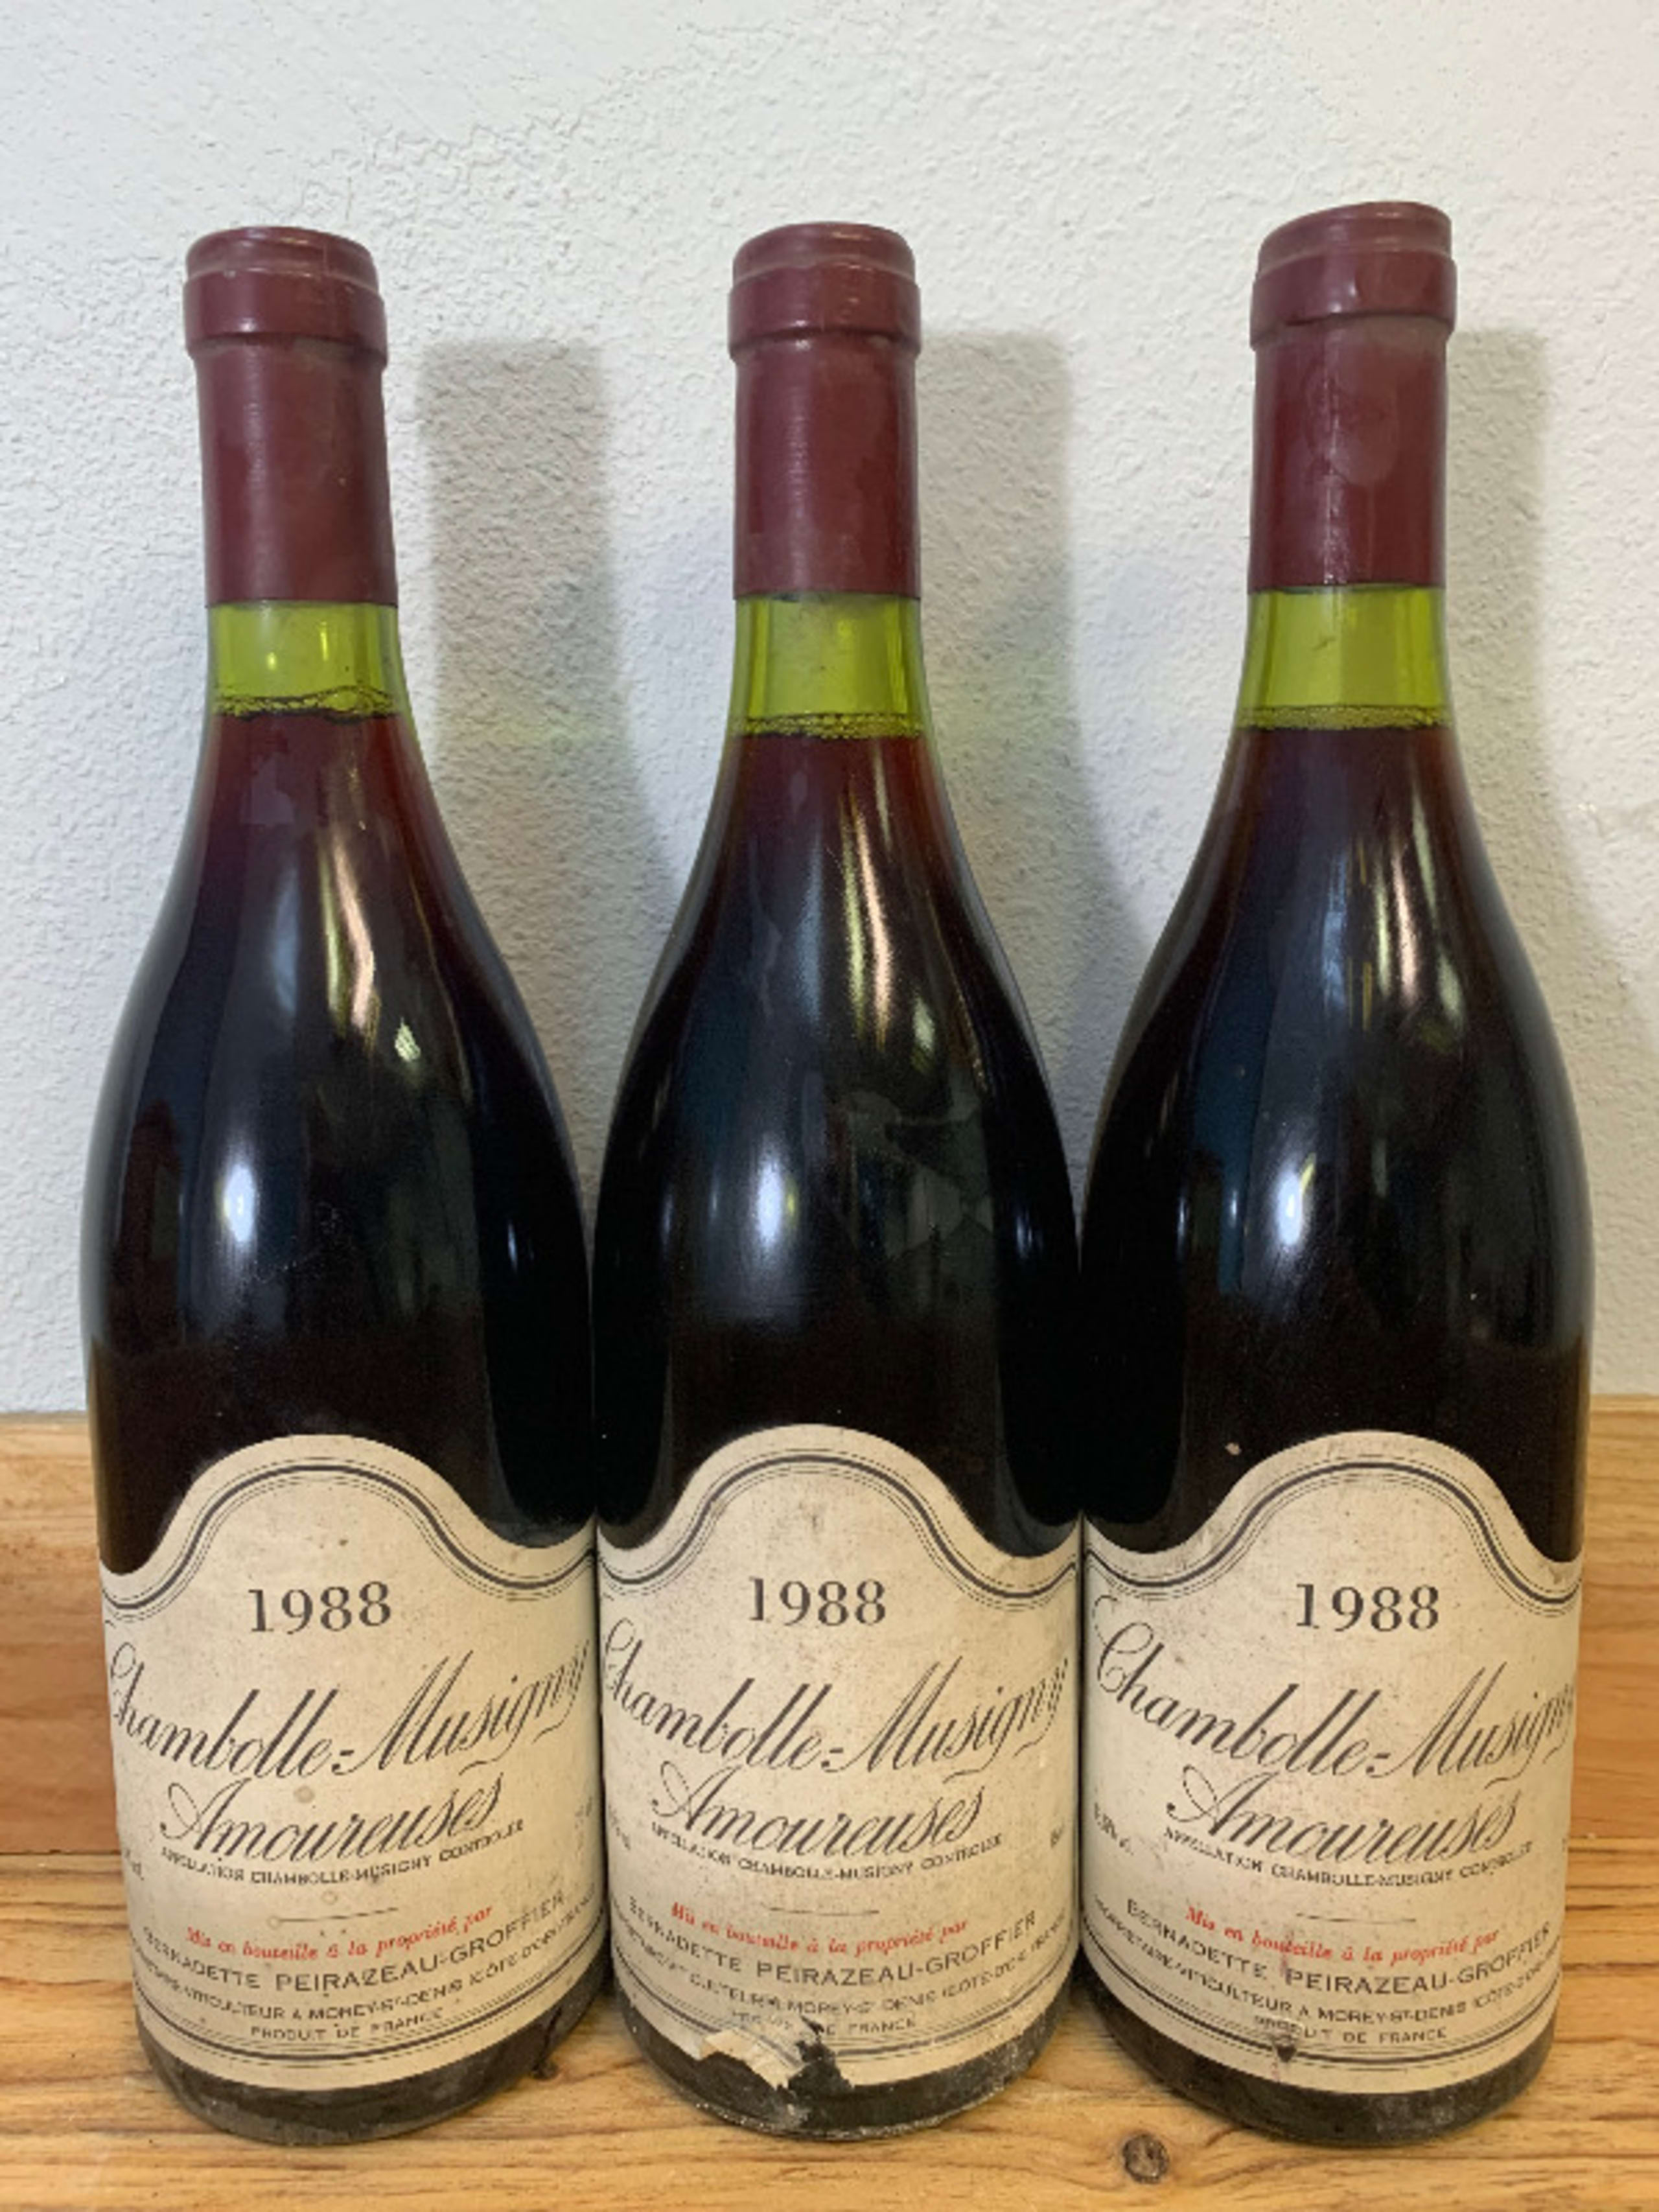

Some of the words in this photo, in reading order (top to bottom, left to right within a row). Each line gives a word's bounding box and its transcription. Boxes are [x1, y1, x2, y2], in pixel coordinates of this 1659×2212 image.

[248, 1581, 392, 1635] 1988
[748, 1576, 887, 1627] 1988
[1295, 1583, 1439, 1633] 1988
[159, 1771, 504, 1862] Amoureuses
[651, 1760, 985, 1858] Amoureuses
[1166, 1765, 1522, 1863] Amoureuses
[187, 1925, 211, 1948] Mis
[218, 1941, 236, 1953] en
[242, 1940, 319, 1961] bouteille
[347, 1940, 368, 1957] la
[375, 1915, 458, 1958] propriété
[463, 1905, 493, 1934] par
[275, 1889, 564, 1992] PEIRAZEAU-GROFFIER
[671, 1902, 695, 1926] Mis
[726, 1924, 798, 1951] bouteille
[828, 1937, 846, 1953] la
[855, 1924, 934, 1957] propriété
[939, 1918, 968, 1944] par
[756, 1909, 1036, 1986] PEIRAZEAU-GROFFIER
[1127, 1898, 1268, 1979] BERNADETTE
[1285, 1920, 1551, 1995] PEIRAZEAU-GROFFIER
[1186, 1905, 1216, 1931] Mis
[1224, 1927, 1244, 1942] en
[1251, 1929, 1333, 1960] bouteille
[1363, 1945, 1382, 1962] la
[1390, 1935, 1467, 1967] propriété
[1472, 1929, 1500, 1955] par
[1343, 2031, 1367, 2043] DE
[1379, 2026, 1447, 2043] FRANCE
